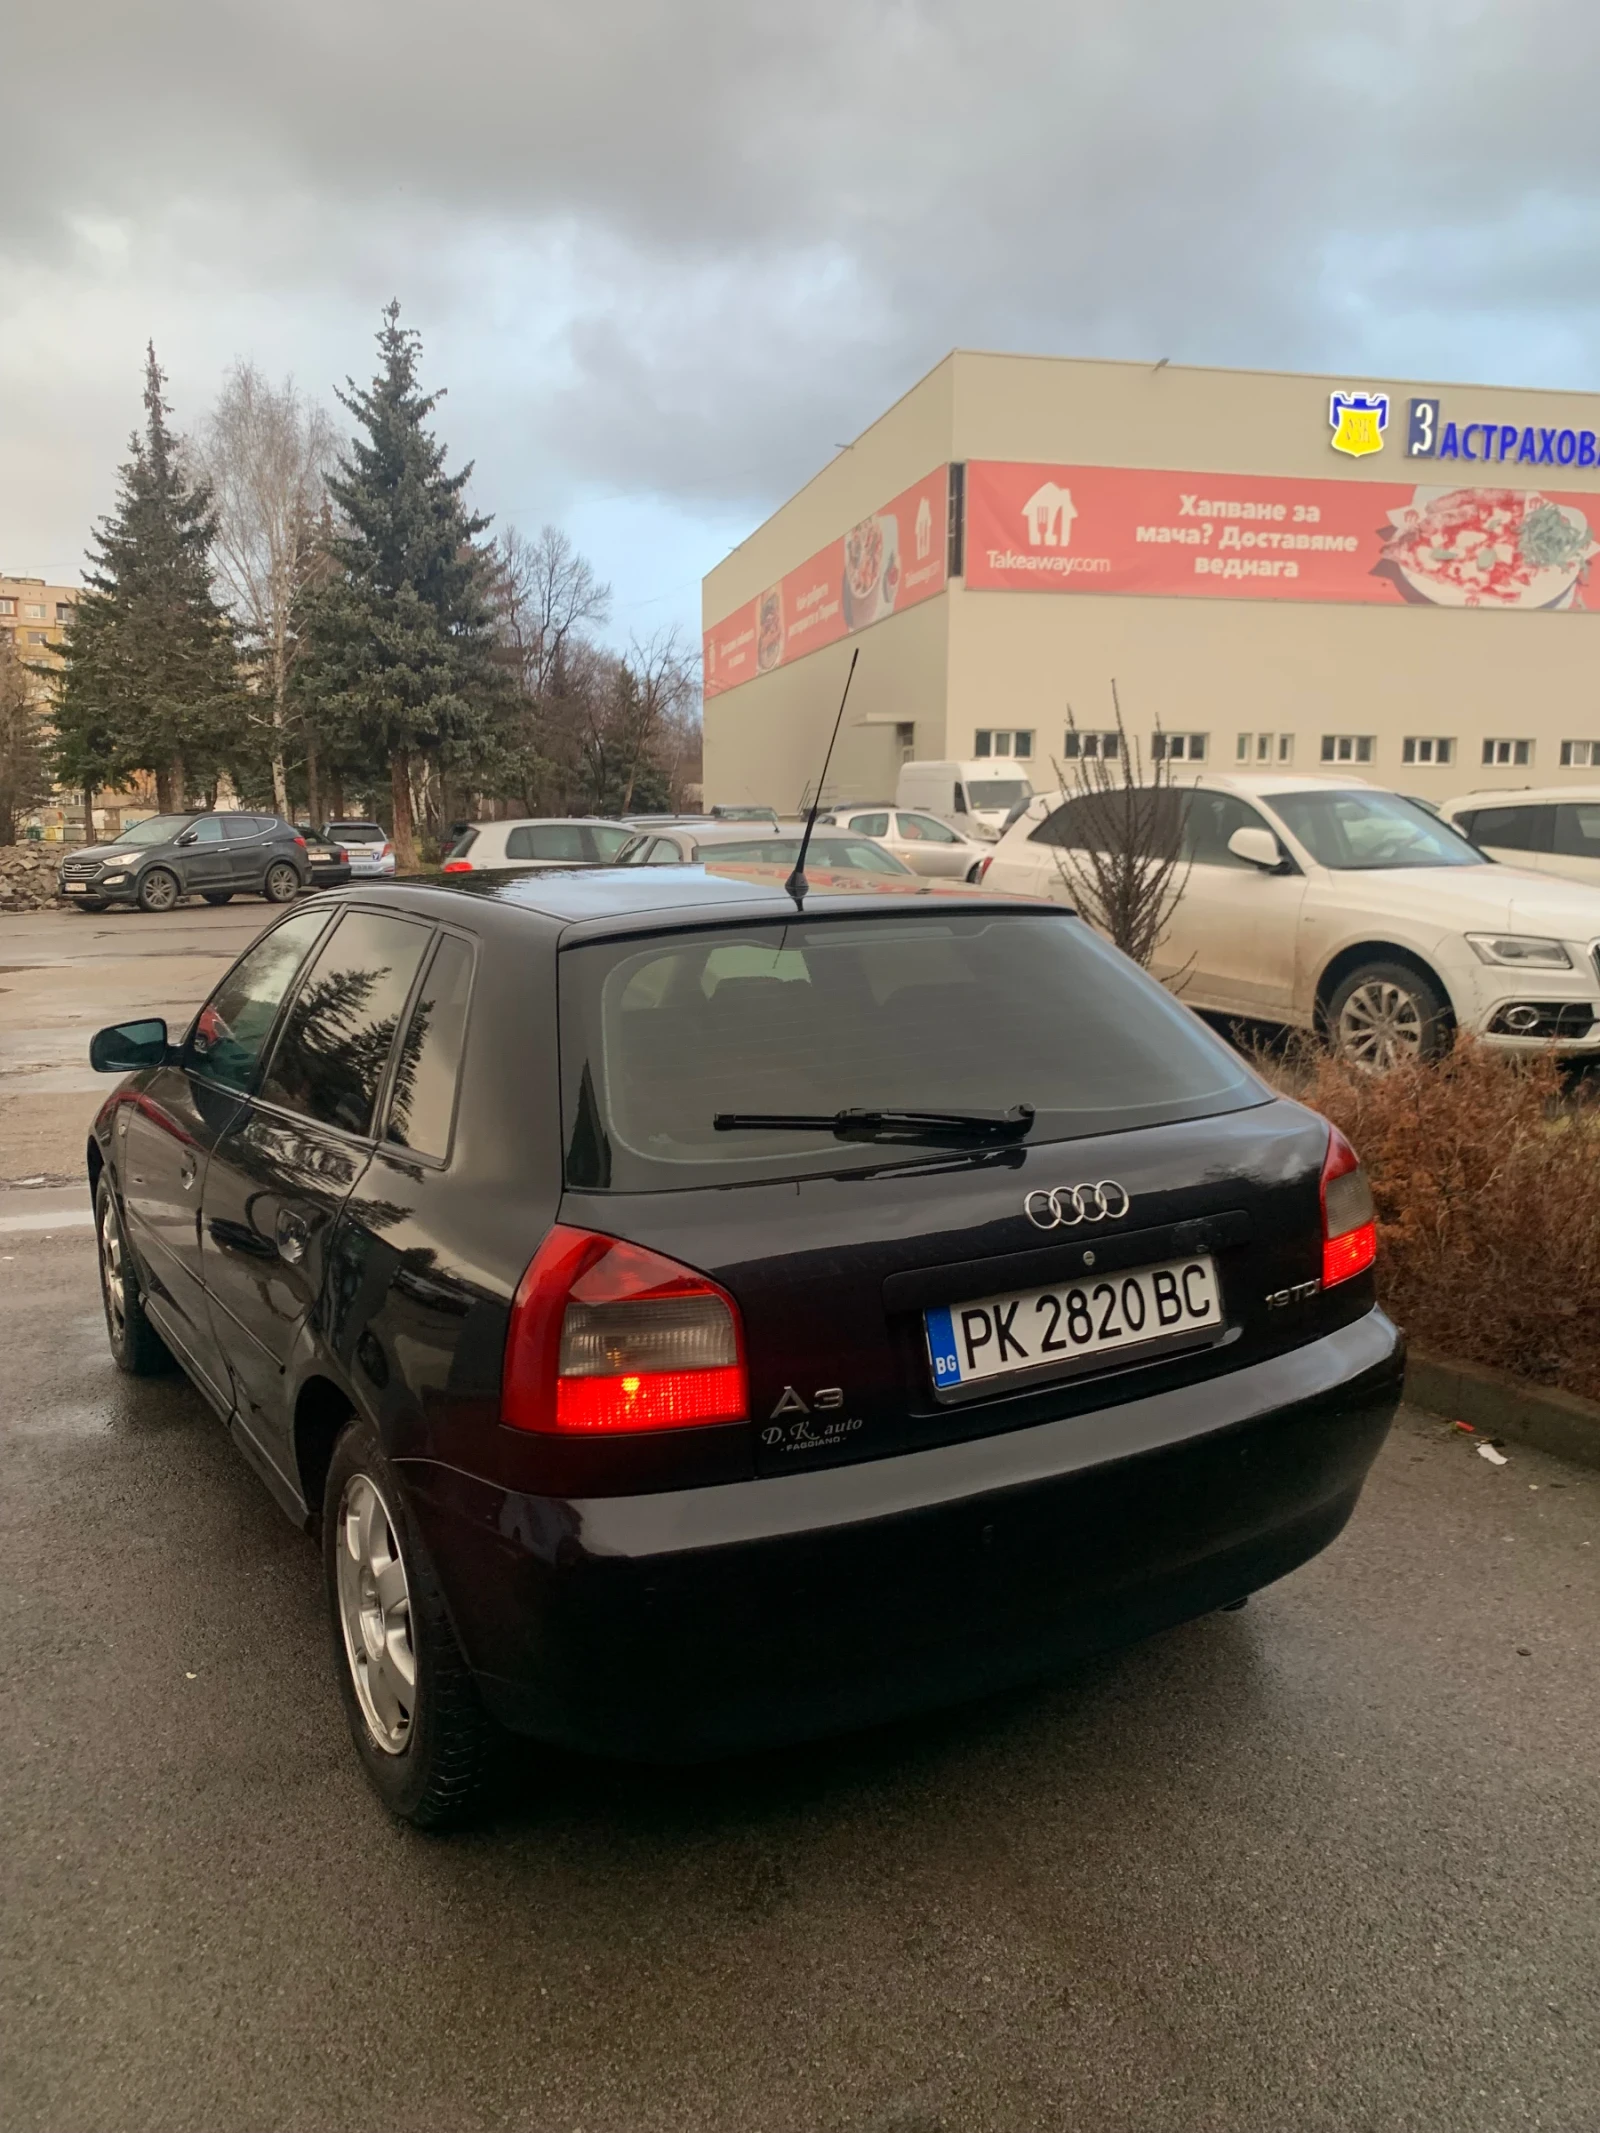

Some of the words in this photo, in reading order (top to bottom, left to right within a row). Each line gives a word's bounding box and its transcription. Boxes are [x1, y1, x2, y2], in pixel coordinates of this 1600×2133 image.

[1411, 403, 1600, 467] ЗАСТРАХОВ
[1178, 494, 1287, 522] Хапване
[1292, 504, 1321, 523] за
[1135, 524, 1214, 546] мача?
[1217, 526, 1359, 553] Доставяме
[986, 550, 1111, 576] Takeaway.com
[1194, 555, 1299, 578] веднага
[961, 1300, 1029, 1369] PK
[1035, 1278, 1146, 1353] 2820
[1152, 1264, 1211, 1326] BC
[935, 1354, 957, 1375] BG
[770, 1386, 843, 1419] A3
[824, 1418, 863, 1436] auto
